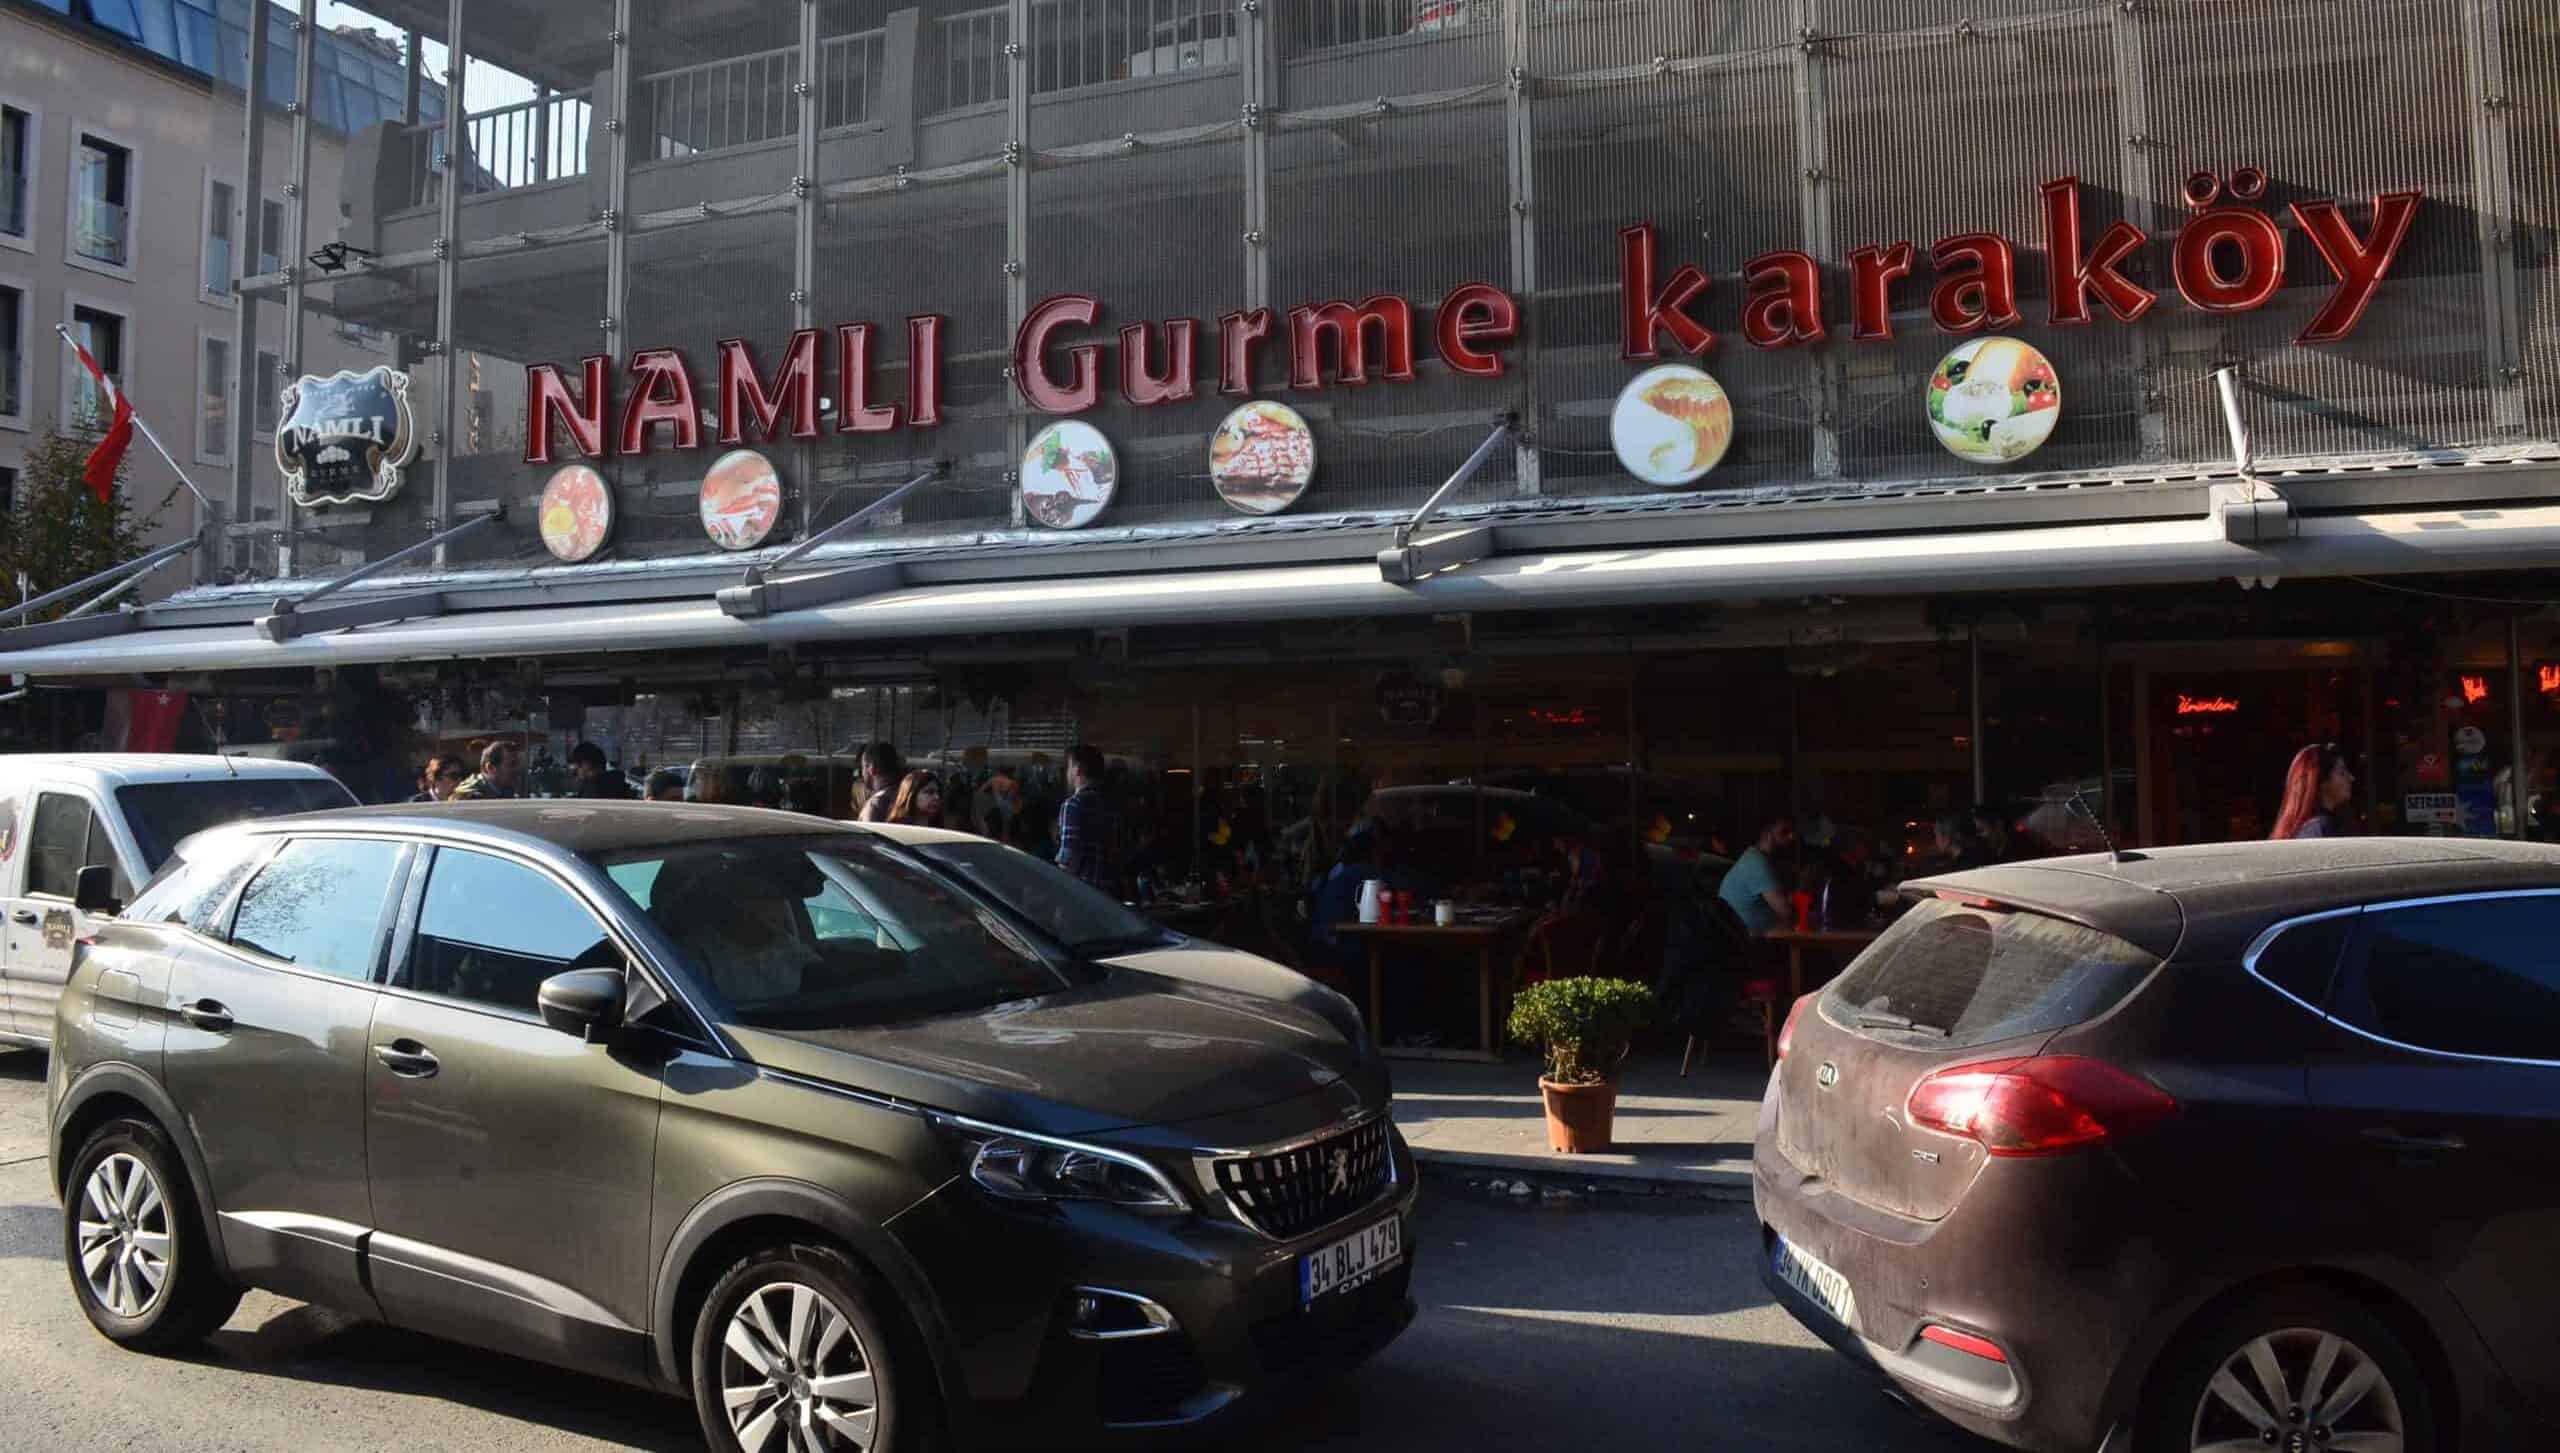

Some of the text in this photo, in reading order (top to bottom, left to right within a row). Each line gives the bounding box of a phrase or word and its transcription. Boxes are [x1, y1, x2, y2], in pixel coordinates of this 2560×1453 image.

[525, 314, 945, 464] NAMLI
[1014, 281, 1519, 415] Gurme
[1619, 166, 2424, 362] karaköy
[293, 415, 385, 453] NAMLI
[1311, 1219, 1398, 1293] 34 BLJ 479
